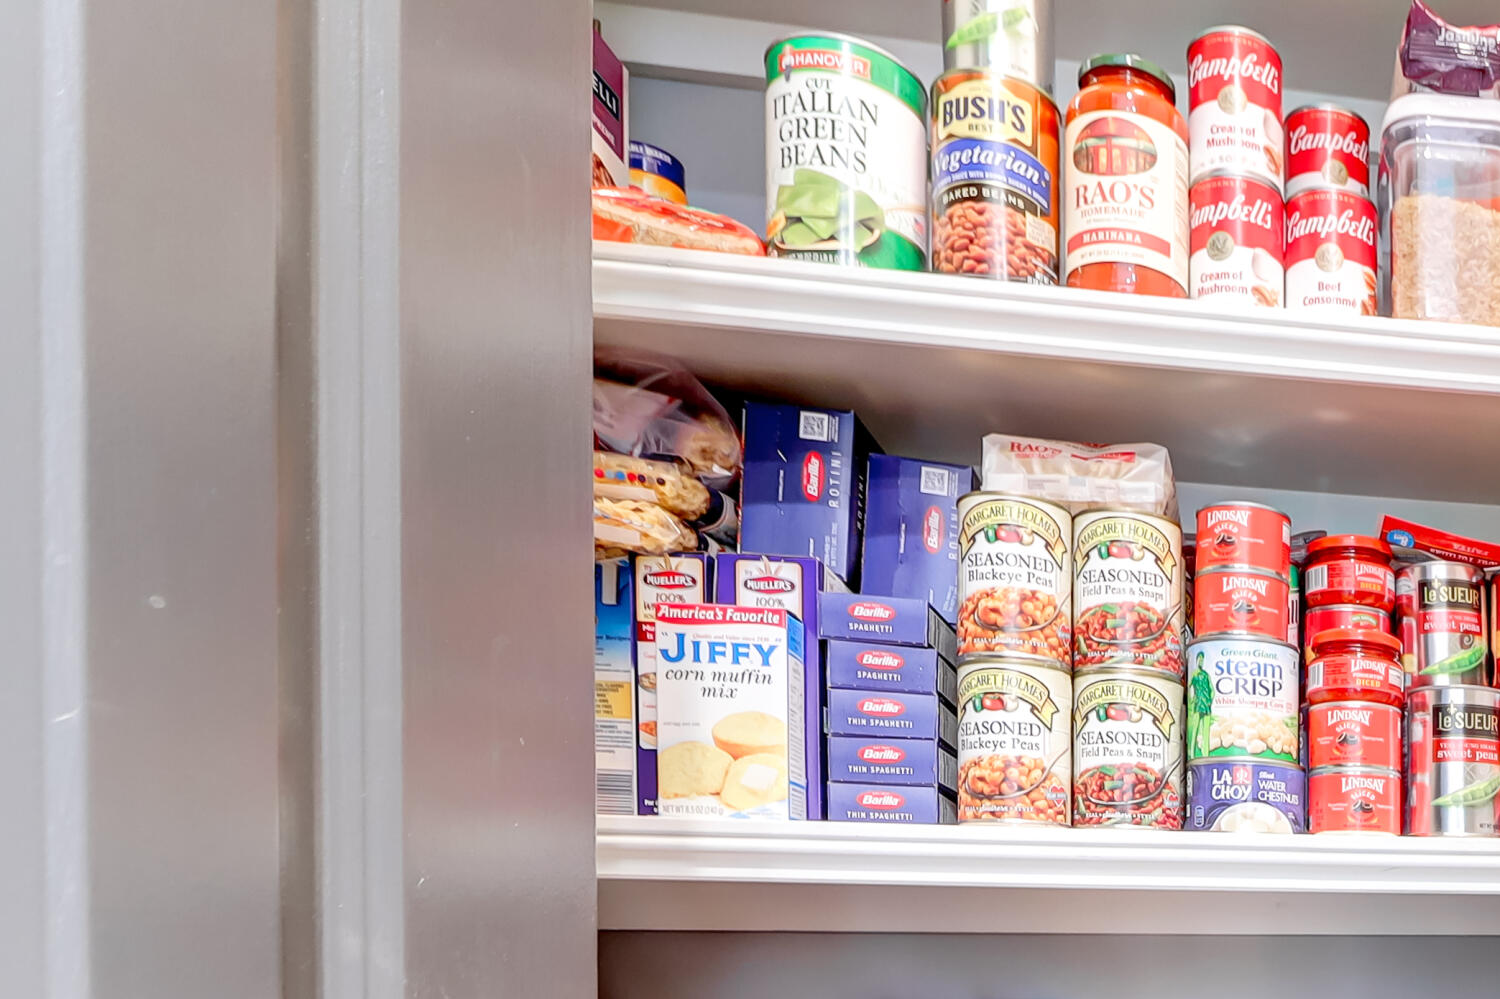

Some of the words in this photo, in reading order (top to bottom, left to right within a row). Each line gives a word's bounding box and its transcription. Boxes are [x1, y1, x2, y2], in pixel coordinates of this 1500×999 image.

[805, 77, 832, 90] CUT
[773, 91, 878, 126] ITALIAN
[943, 96, 1025, 133] BUSH'S
[779, 117, 867, 148] GREEN
[781, 144, 867, 174] BEANS
[1075, 180, 1154, 209] RAO'S
[1200, 271, 1230, 283] Cream
[1232, 271, 1243, 280] of
[1197, 283, 1248, 297] Mushroom
[1317, 281, 1341, 291] Beef
[807, 456, 820, 497] Barilla
[829, 451, 841, 507] ROTINI
[966, 505, 1014, 527] MARGARET
[1018, 506, 1057, 538] HOLMES
[1207, 510, 1250, 526] LINDSAY
[928, 511, 938, 548] Barilla
[1081, 521, 1129, 547] MARGARET
[1133, 523, 1168, 552] HOLMES
[968, 552, 1054, 574] SEASONED
[1355, 563, 1385, 578] LINDSAY
[968, 569, 1022, 583] Blackeye
[1027, 571, 1053, 588] Peas
[1082, 568, 1164, 588] SEASONED
[1222, 577, 1268, 597] LINDSAY
[656, 593, 685, 603] 100%
[658, 604, 723, 620] America's
[726, 610, 780, 624] Favorite
[854, 606, 890, 618] Barilla
[849, 623, 893, 633] SPAGHETTI
[862, 654, 898, 667] Barilla
[1221, 648, 1251, 657] Green
[1252, 648, 1278, 660] Giant
[665, 666, 704, 681] corn
[711, 668, 772, 684] muffin
[1215, 659, 1283, 680] steam
[1351, 659, 1386, 675] LINDSAY
[857, 671, 901, 681] SPAGHETTI
[701, 686, 738, 699] mix
[1215, 677, 1283, 697] CRISP
[1079, 684, 1124, 708] MARGARET
[1126, 685, 1165, 713] HOLMES
[863, 702, 899, 713] Barilla
[848, 718, 866, 726] THIN
[870, 719, 912, 728] SPAGHETTI
[1328, 710, 1373, 726] LINDSAY
[960, 721, 1041, 737] SEASONED
[961, 739, 1007, 752] Blackeye
[1012, 739, 1040, 751] Peas
[1081, 731, 1162, 748] SEASONED
[863, 749, 899, 760] Barilla
[848, 765, 867, 773] THIN
[871, 766, 913, 775] SPAGHETTI
[1212, 769, 1232, 785] LA
[1212, 785, 1252, 800] CHOY
[1258, 780, 1286, 792] WATER
[1341, 777, 1386, 794] LINDSAY
[863, 795, 899, 806] Barilla
[847, 811, 866, 819] THIN
[870, 812, 913, 821] SPAGHETTI
